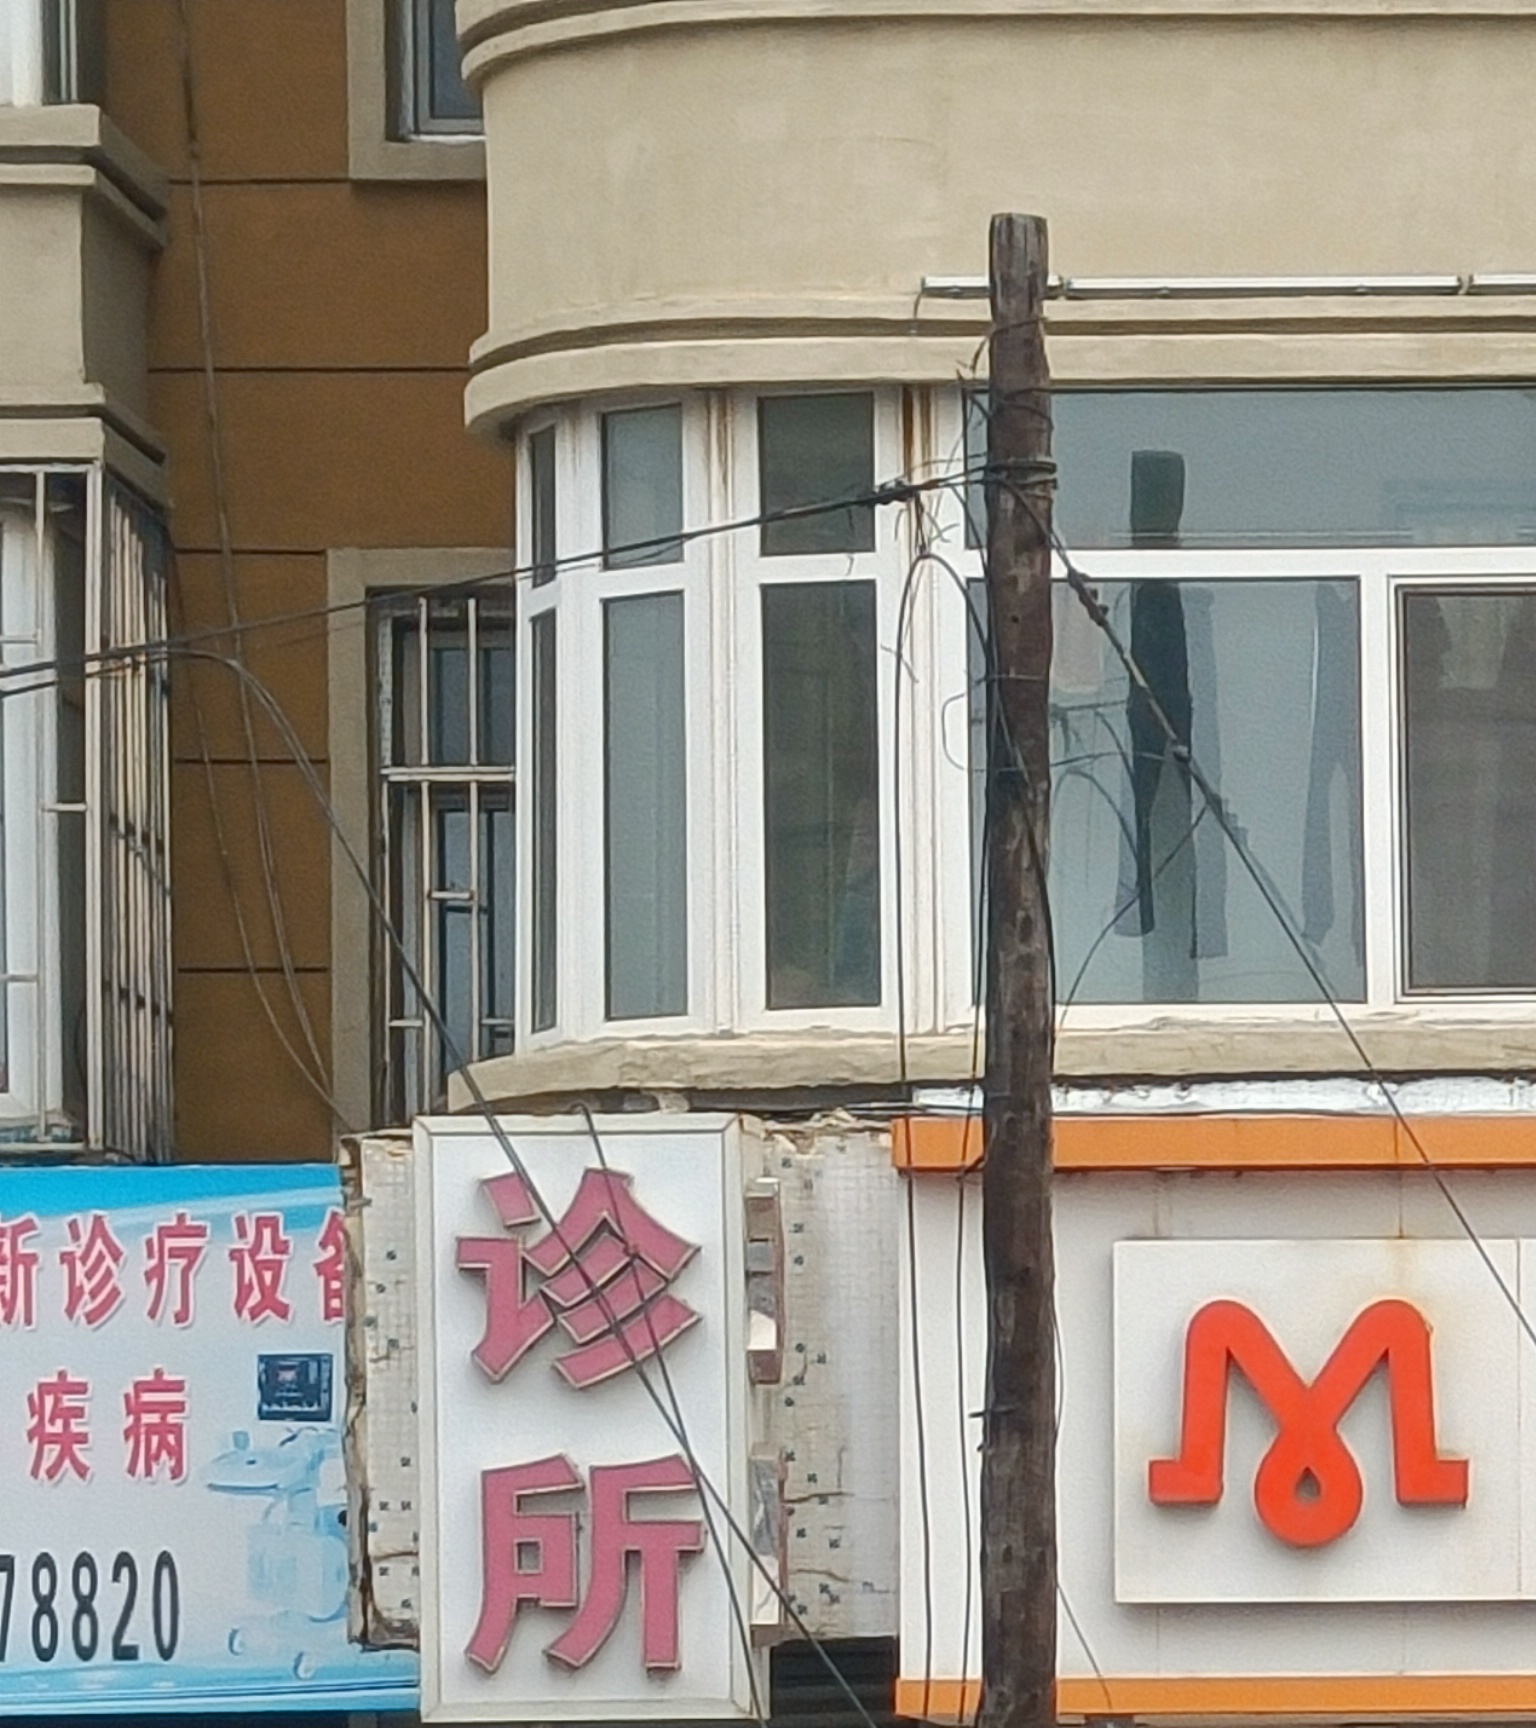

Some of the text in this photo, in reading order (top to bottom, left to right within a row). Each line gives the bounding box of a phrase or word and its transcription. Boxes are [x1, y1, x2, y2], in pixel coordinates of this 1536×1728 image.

[27, 1367, 191, 1483] 疾病
[457, 1167, 703, 1675] 诊所
[0, 1550, 180, 1663] 78820
